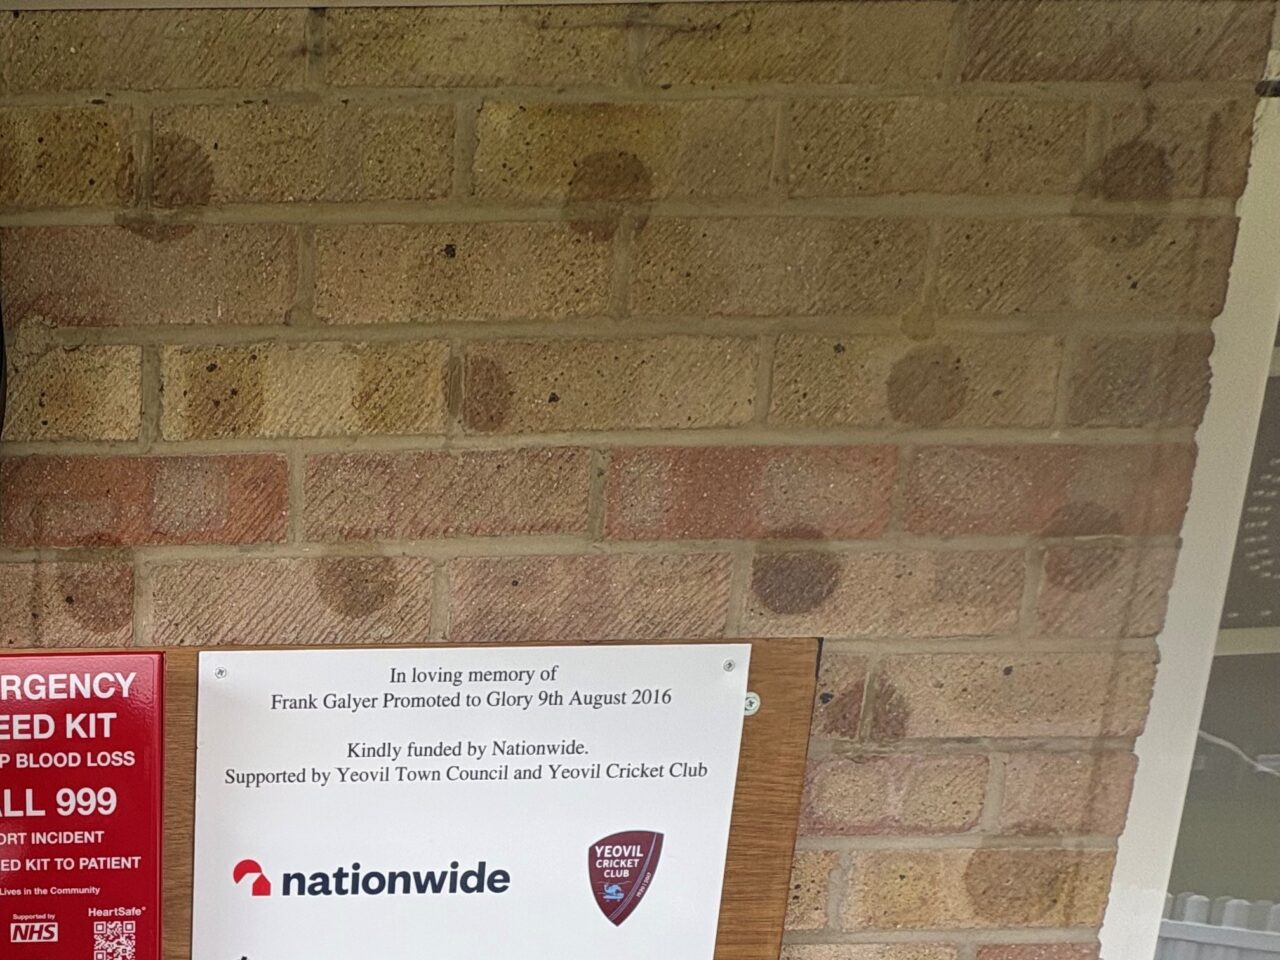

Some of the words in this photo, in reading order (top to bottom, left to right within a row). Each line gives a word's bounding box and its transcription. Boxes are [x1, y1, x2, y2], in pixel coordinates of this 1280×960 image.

[391, 668, 406, 683] In
[412, 667, 462, 686] loving
[469, 671, 535, 685] memory
[540, 665, 559, 681] of
[272, 694, 317, 709] Frank
[324, 694, 378, 712] Galyer
[384, 692, 460, 708] Promoted
[467, 695, 481, 707] to
[487, 691, 533, 710] Glory
[539, 691, 563, 705] 9th
[569, 691, 626, 709] August
[632, 689, 671, 704] 2016
[66, 713, 117, 738] KIT
[348, 743, 401, 761] Kindly
[408, 742, 461, 756] funded
[468, 741, 486, 760] by
[493, 740, 588, 755] Nationwide.
[16, 752, 81, 768] BLOOD
[87, 751, 135, 766] LOSS
[225, 768, 305, 787] Supported
[312, 768, 330, 786] by
[337, 767, 389, 782] Yeovil
[395, 767, 440, 781] Town
[447, 765, 508, 780] Council
[514, 765, 542, 779] and
[549, 764, 600, 779] Yeovil
[606, 763, 663, 778] Cricket
[669, 763, 707, 777] Club
[56, 787, 116, 816] 999
[32, 831, 104, 844] INCIDENT
[595, 845, 643, 857] YEOVIL
[26, 859, 50, 870] KIT
[54, 858, 74, 870] TO
[80, 857, 141, 869] PATIENT
[596, 859, 639, 868] CRICKET
[283, 861, 510, 895] nationwide
[604, 869, 629, 877] CLUB
[0, 888, 21, 896] Lives
[24, 888, 31, 896] in
[34, 887, 48, 895] the
[50, 887, 100, 895] Community
[12, 924, 55, 940] NHS
